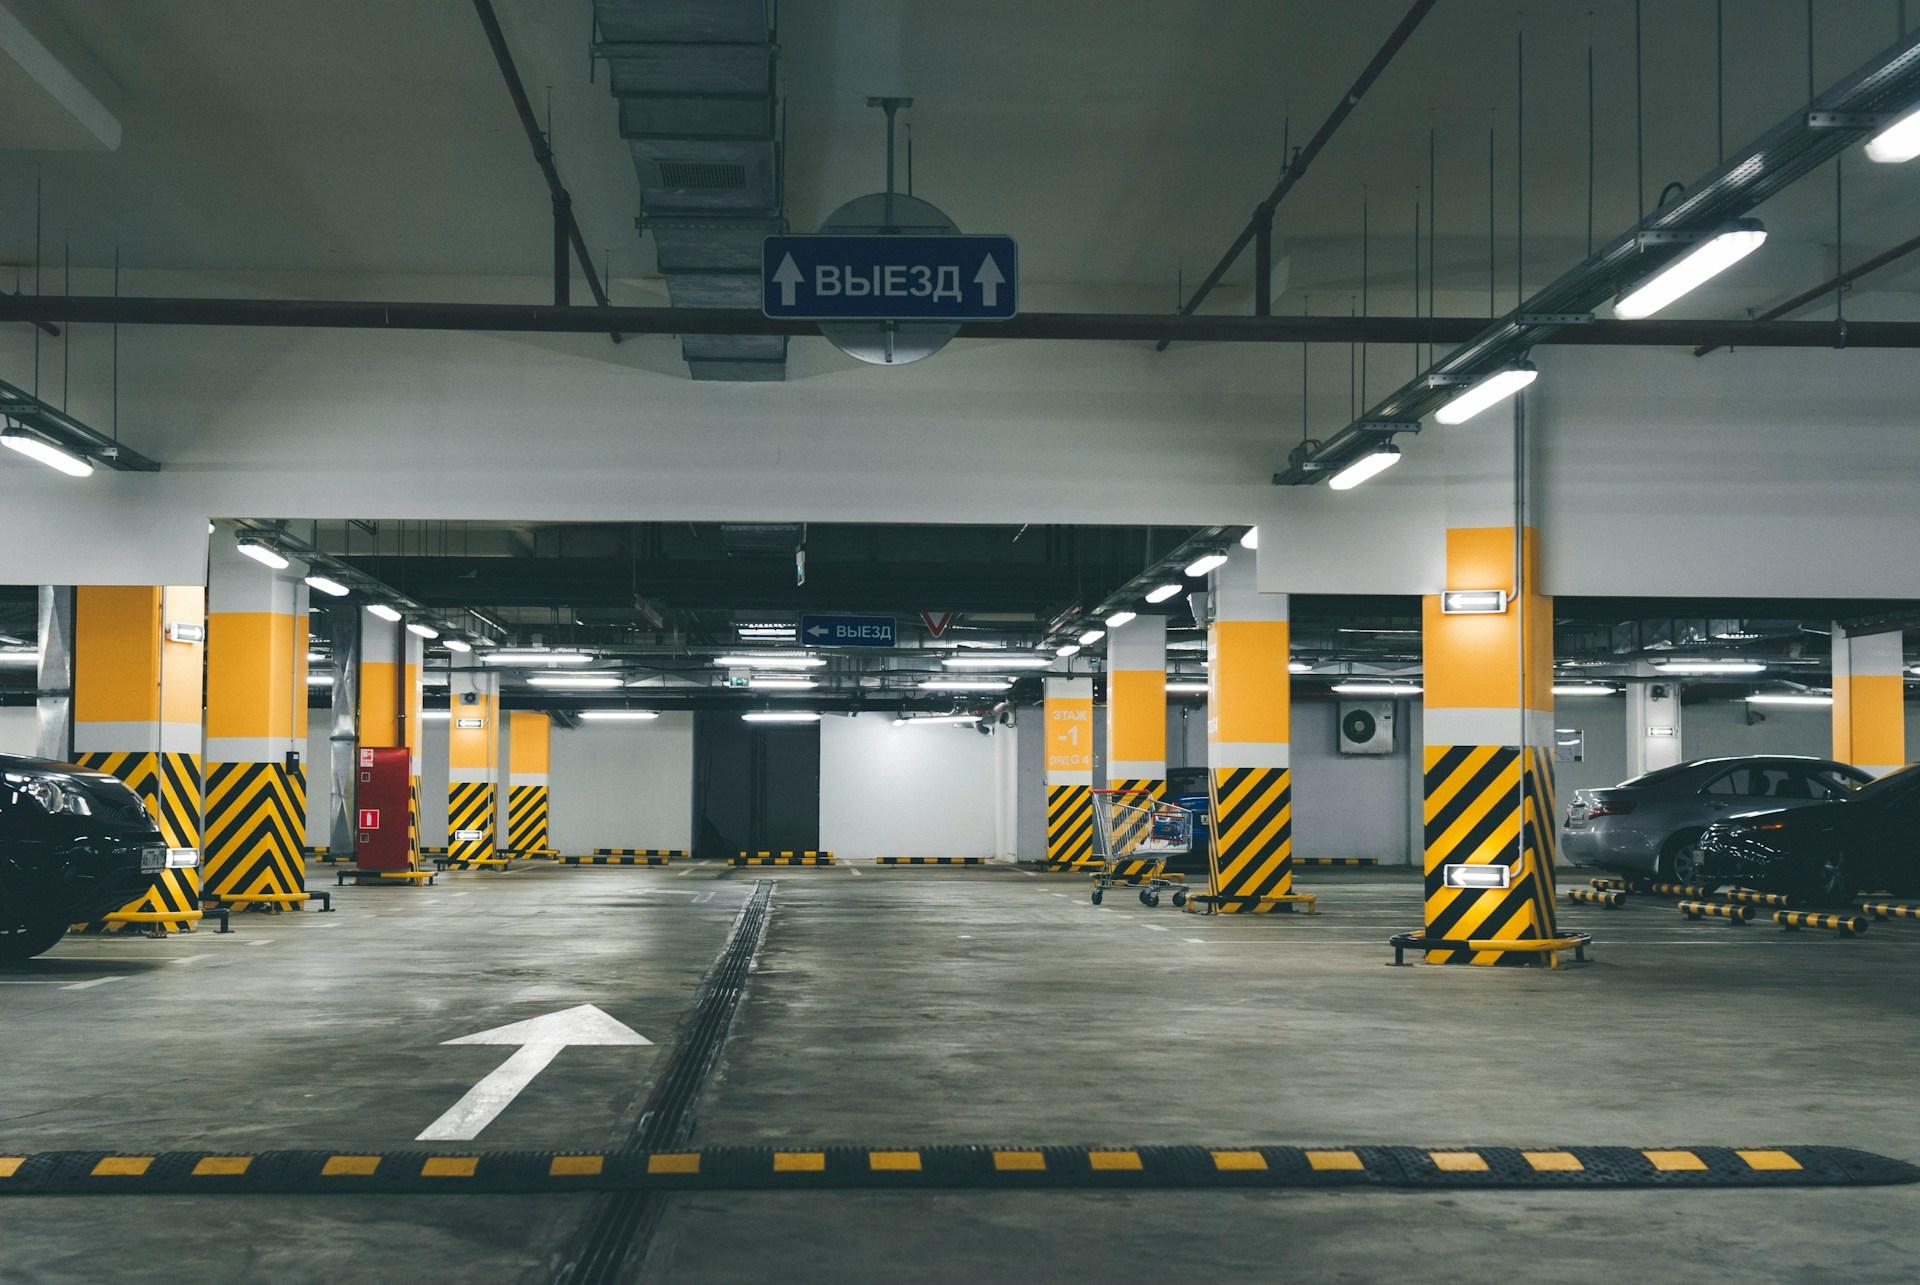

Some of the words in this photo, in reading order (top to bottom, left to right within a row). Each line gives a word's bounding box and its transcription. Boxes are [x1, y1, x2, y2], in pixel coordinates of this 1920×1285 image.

[816, 265, 962, 303] ВЫЕЗД
[836, 625, 892, 640] ВЫЕЗД
[1053, 711, 1087, 721] ЭТАЖ
[1057, 725, 1079, 746] -1
